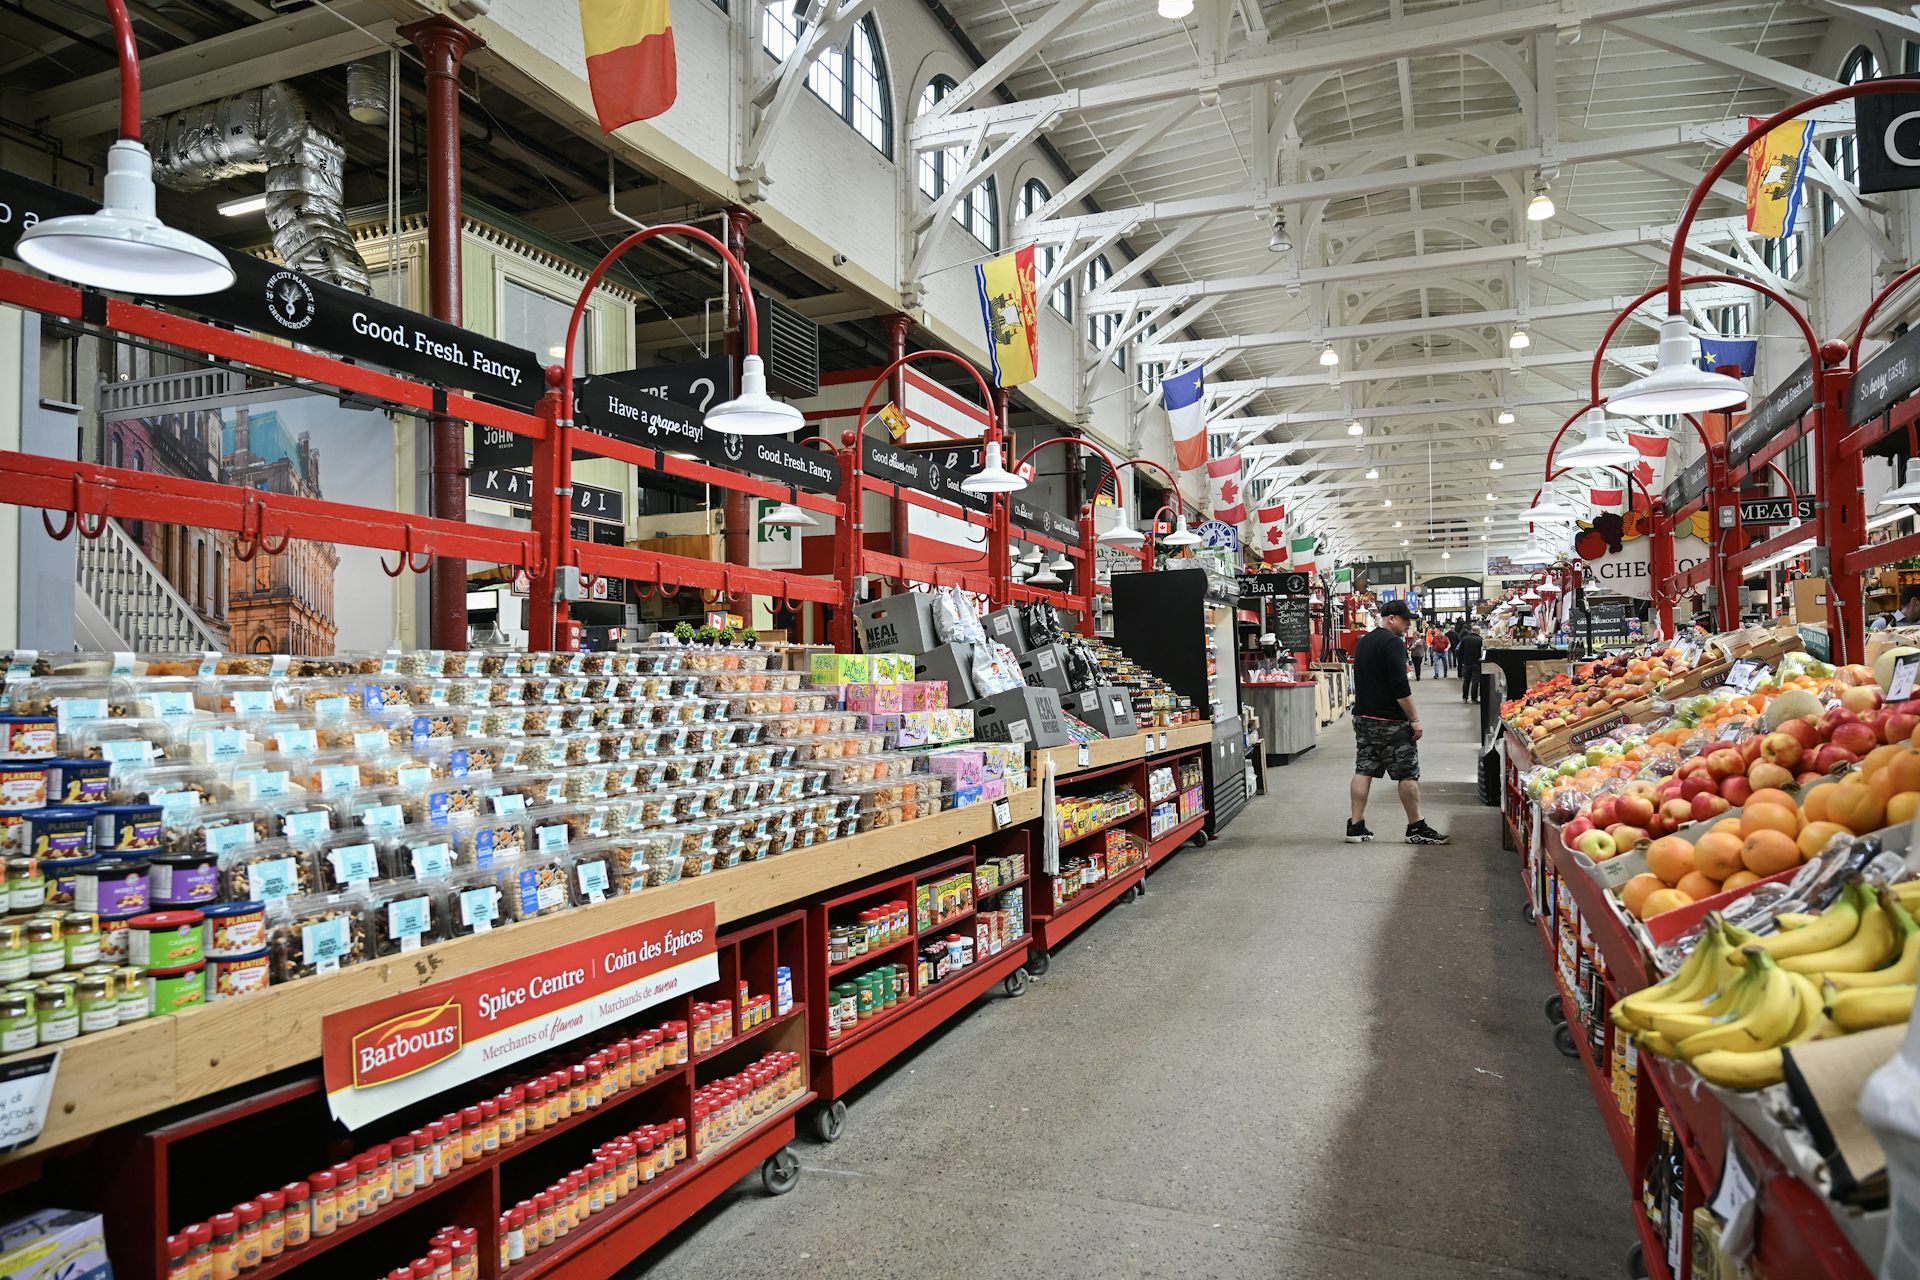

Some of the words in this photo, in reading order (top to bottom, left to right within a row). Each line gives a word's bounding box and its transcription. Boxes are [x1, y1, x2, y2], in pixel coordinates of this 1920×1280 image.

[266, 274, 279, 289] THE
[276, 271, 292, 280] CITY
[292, 273, 315, 303] MARKET
[268, 304, 313, 329] GREENGROCER
[352, 312, 409, 348] Good.
[414, 331, 468, 367] Fresh.
[472, 350, 523, 387] Fancy.
[1860, 383, 1869, 401] So
[1887, 357, 1908, 382] tasty.
[608, 395, 639, 420] Have
[640, 410, 649, 424] a
[647, 414, 681, 436] grape
[681, 420, 704, 443] day!
[484, 428, 514, 445] JOHN
[757, 444, 782, 465] Good.
[784, 452, 808, 473] Fresh.
[808, 460, 833, 482] Fancy.
[872, 448, 888, 464] Good
[904, 461, 918, 479] only.
[946, 477, 961, 492] Good.
[1740, 501, 1811, 520] MEATS
[1251, 583, 1275, 593] BAR
[1276, 600, 1290, 611] Self
[865, 623, 898, 643] NEAL
[867, 636, 899, 650] BROTHERS
[3, 771, 42, 780] PLANTERS
[521, 888, 536, 898] fresh
[225, 911, 263, 925] PLANTERS
[229, 956, 268, 970] PLANTERS
[604, 947, 638, 974] Coin
[639, 940, 662, 962] des
[663, 928, 704, 956] Épices
[478, 987, 526, 1020] Spice
[529, 967, 585, 999] Centre
[599, 990, 643, 1017] Marchands
[642, 986, 653, 999] de
[360, 1024, 457, 1074] Barbours
[482, 1033, 537, 1062] Merchants
[538, 1023, 549, 1040] of
[549, 1014, 584, 1041] flavour
